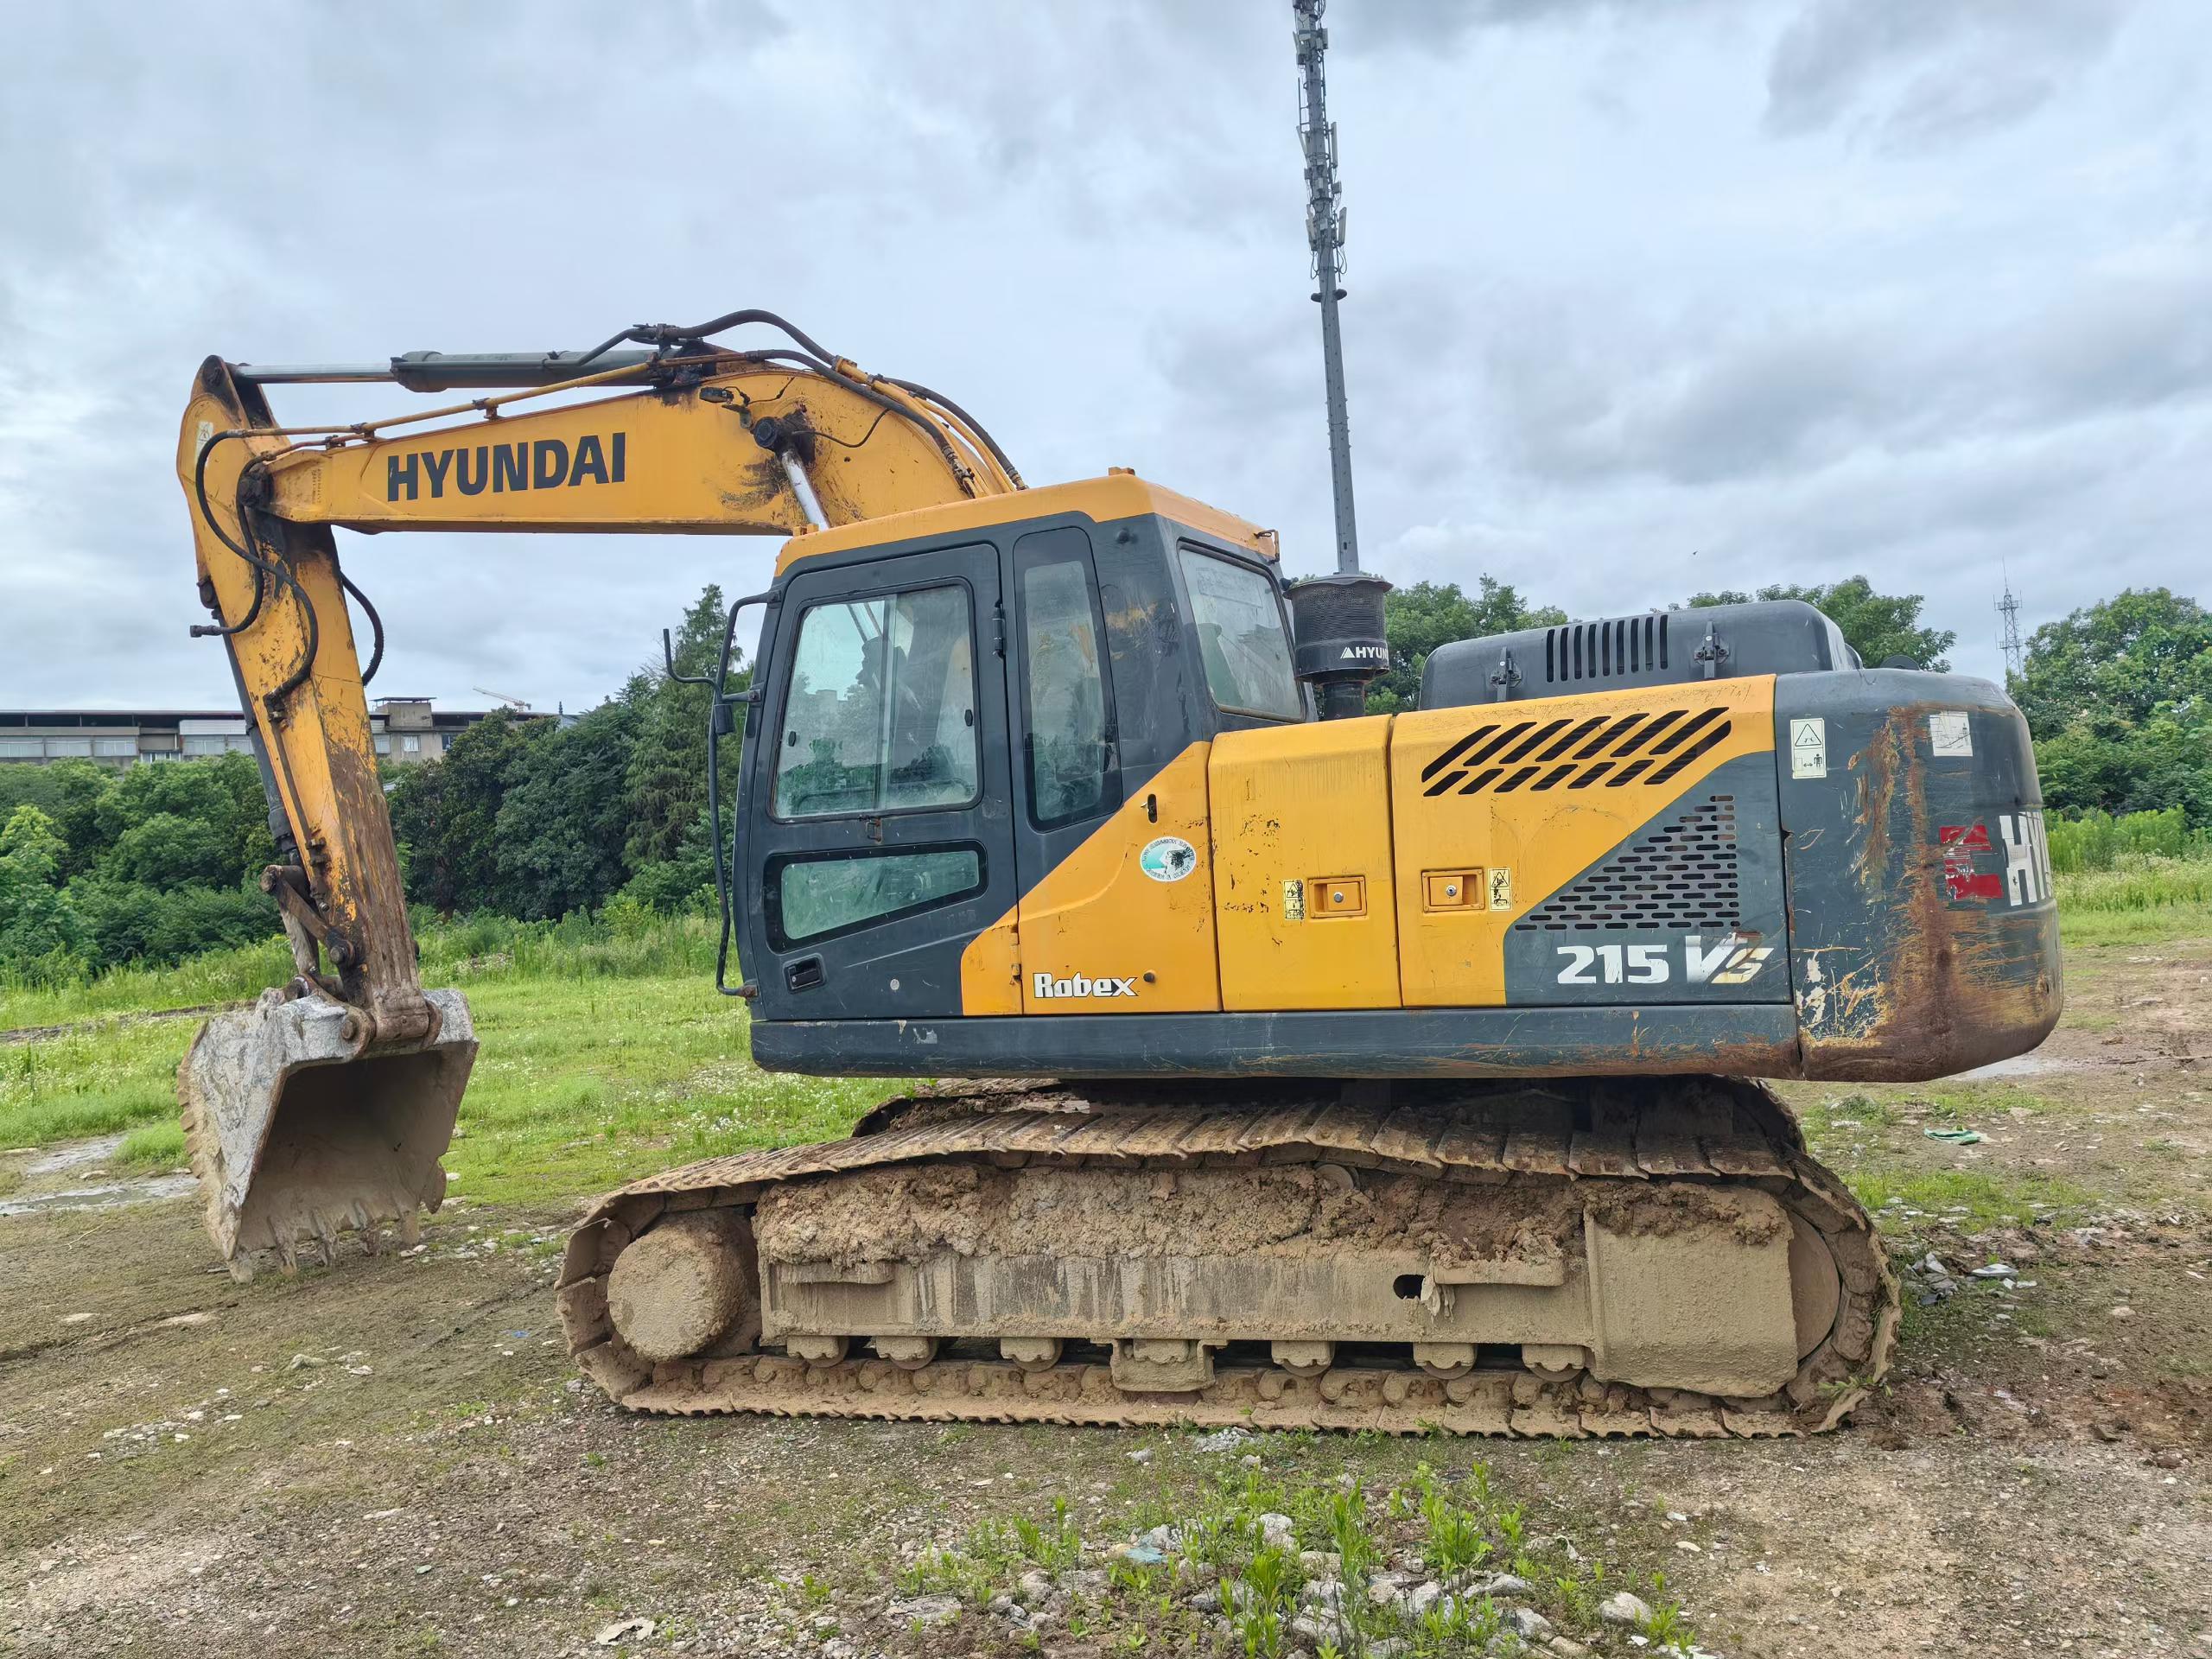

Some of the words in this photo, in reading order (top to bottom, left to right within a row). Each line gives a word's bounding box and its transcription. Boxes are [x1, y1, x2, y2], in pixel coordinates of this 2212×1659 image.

[388, 432, 626, 501] HYUNDAI
[1557, 944, 1669, 984] 215
[1033, 971, 1139, 998] Robex
